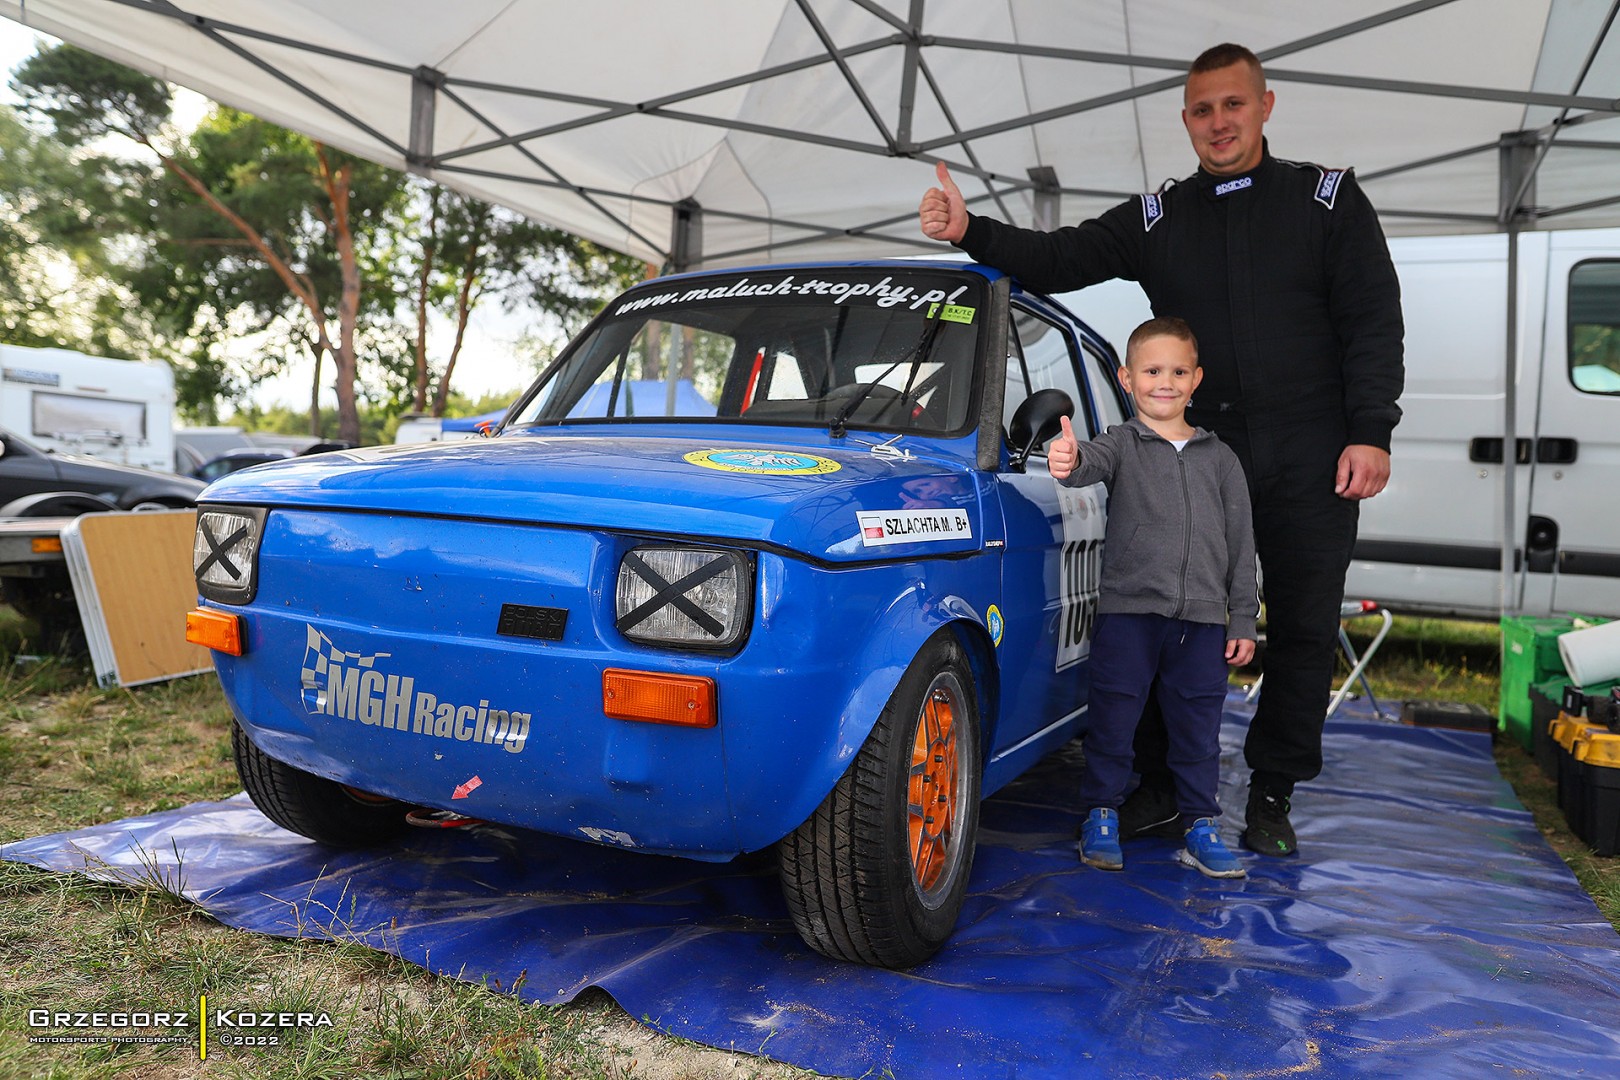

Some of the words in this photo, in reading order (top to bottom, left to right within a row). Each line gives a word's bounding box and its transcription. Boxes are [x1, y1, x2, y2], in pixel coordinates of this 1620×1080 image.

[1215, 177, 1252, 195] sparco
[614, 276, 969, 315] www.maluch-trophy.pl
[885, 517, 941, 535] SZLACHTA
[941, 516, 953, 532] M.
[955, 516, 967, 532] B+
[327, 663, 415, 731] MGH
[413, 691, 532, 753] Racing
